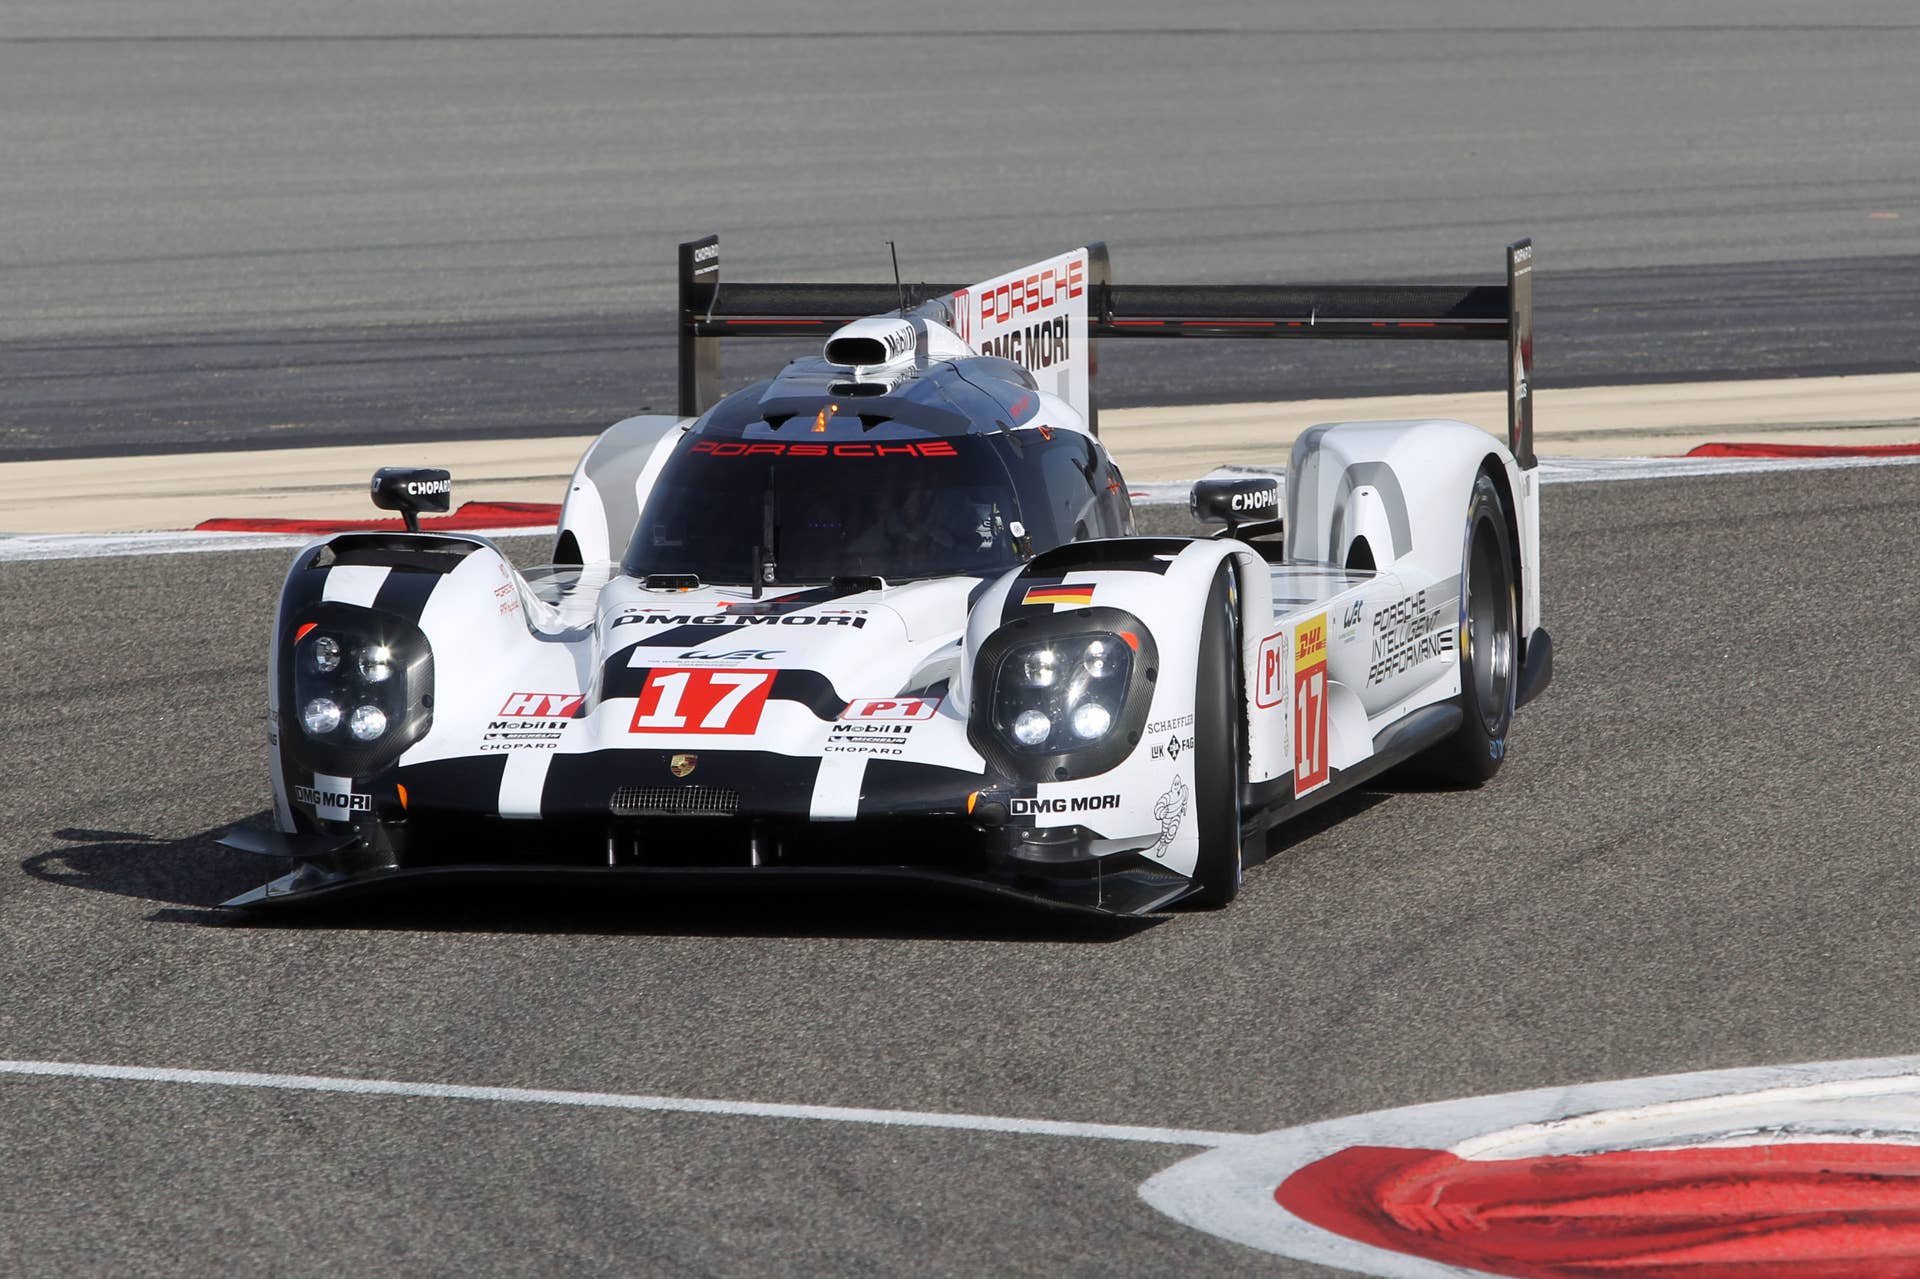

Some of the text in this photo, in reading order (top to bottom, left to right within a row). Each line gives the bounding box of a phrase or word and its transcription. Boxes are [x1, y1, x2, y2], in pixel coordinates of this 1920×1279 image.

[981, 260, 1082, 329] PORSCHE
[1026, 314, 1069, 372] MORI
[688, 441, 958, 457] PORSCHE
[611, 615, 867, 630] DMG MORI
[1373, 589, 1426, 637] PORSCHE
[1371, 609, 1441, 663] INTELLIGENT
[678, 649, 787, 661] WEC
[1265, 647, 1281, 695] P1
[501, 694, 582, 716] HY
[637, 672, 769, 729] 17
[860, 701, 924, 716] P1
[488, 721, 547, 729] Mobil
[832, 725, 891, 733] Mobil
[1298, 671, 1324, 780] 17
[480, 743, 558, 751] CHOPARD
[824, 747, 903, 755] CHOPARD
[295, 786, 371, 810] DMG MORI
[1012, 794, 1121, 814] DMG MORI
